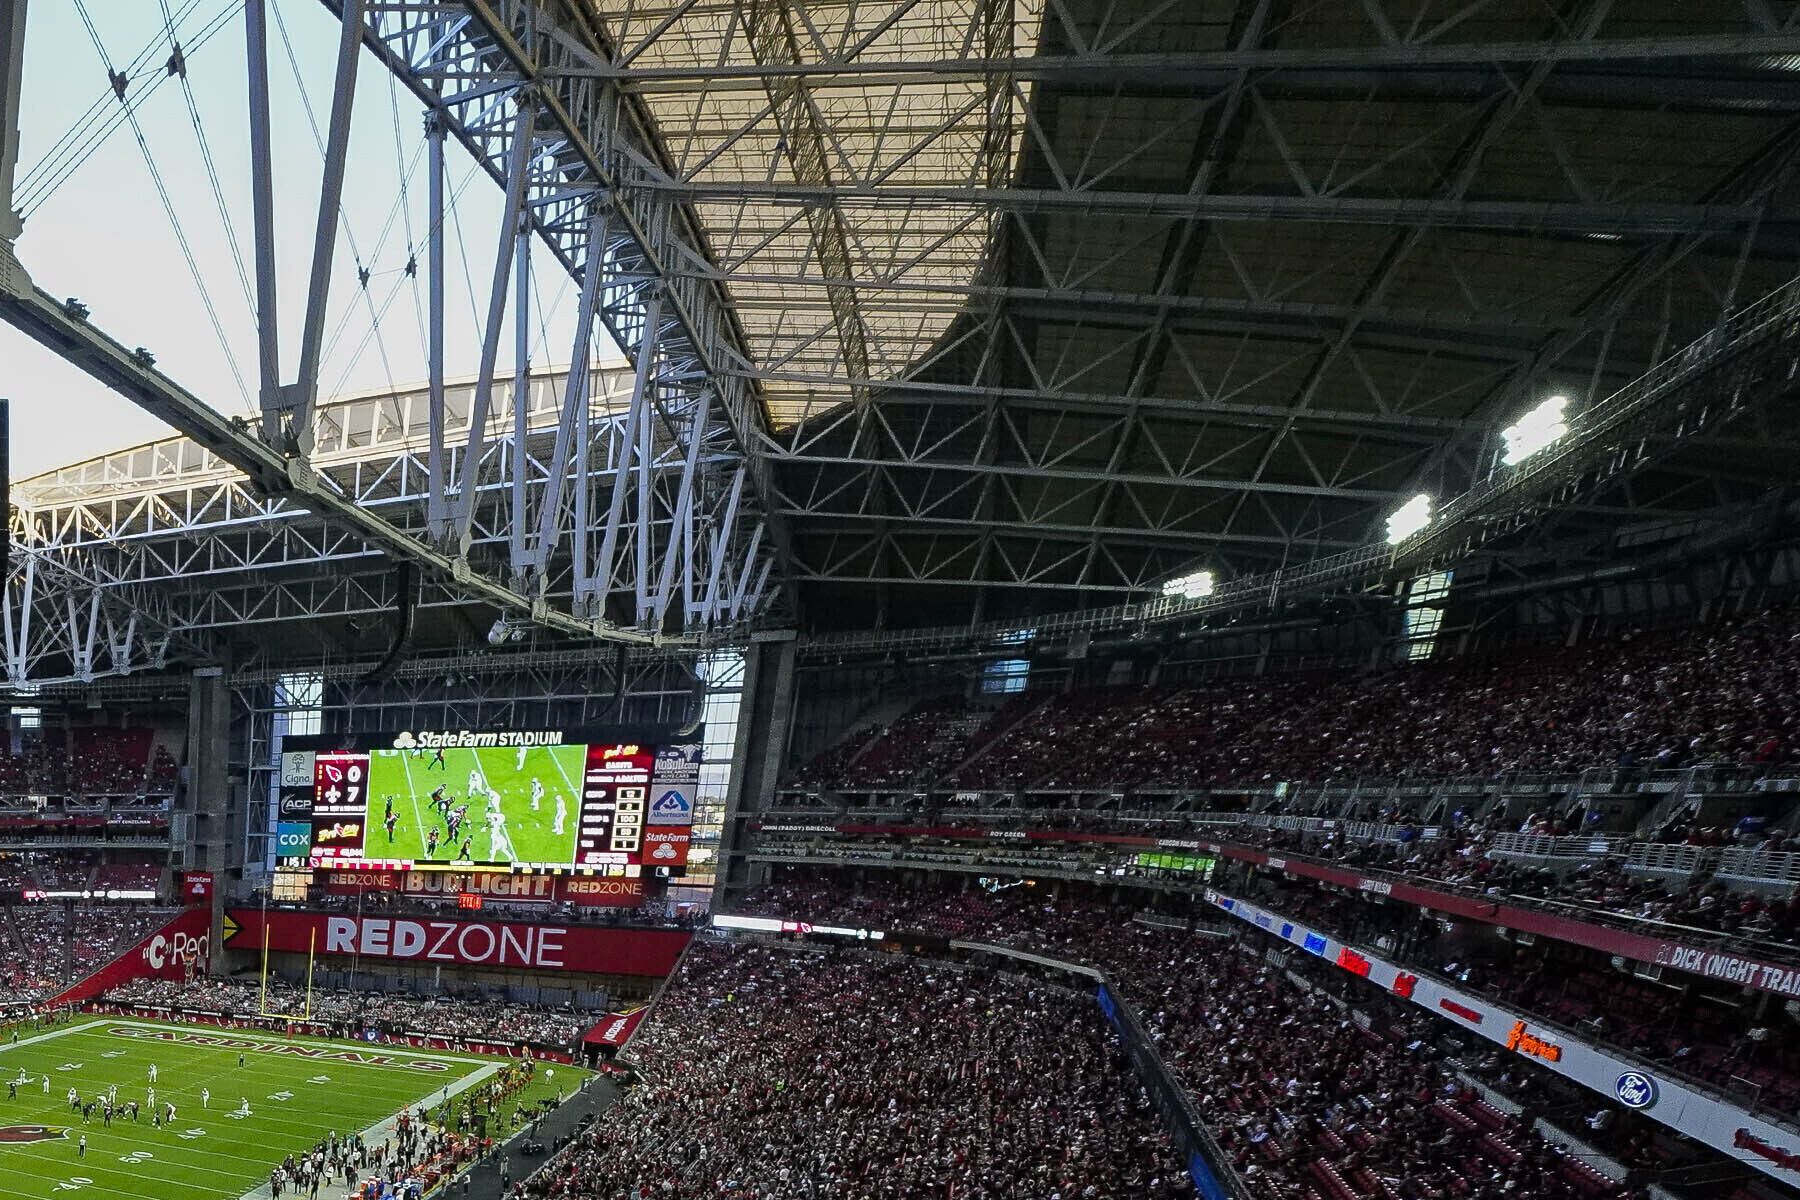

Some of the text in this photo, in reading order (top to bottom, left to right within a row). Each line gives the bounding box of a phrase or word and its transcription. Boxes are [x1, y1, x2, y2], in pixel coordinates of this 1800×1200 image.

[499, 732, 563, 746] STADIUM
[285, 774, 310, 786] Cigna
[347, 766, 361, 783] 0
[347, 787, 360, 802] 7
[286, 800, 312, 808] ACP
[279, 834, 309, 846] COX
[329, 873, 392, 887] REDZONE
[406, 871, 550, 897] BUD LIGHT
[566, 880, 643, 896] REDZONE
[172, 927, 210, 965] Red
[327, 916, 567, 967] REDZONE
[1671, 946, 1706, 971] DICK
[1703, 954, 1760, 984] (NIGHT
[1760, 965, 1800, 996] TRAI
[106, 1026, 456, 1073] CARDINALS
[1619, 1075, 1647, 1104] Ford
[119, 1151, 154, 1165] 50
[57, 1176, 94, 1192] 40
